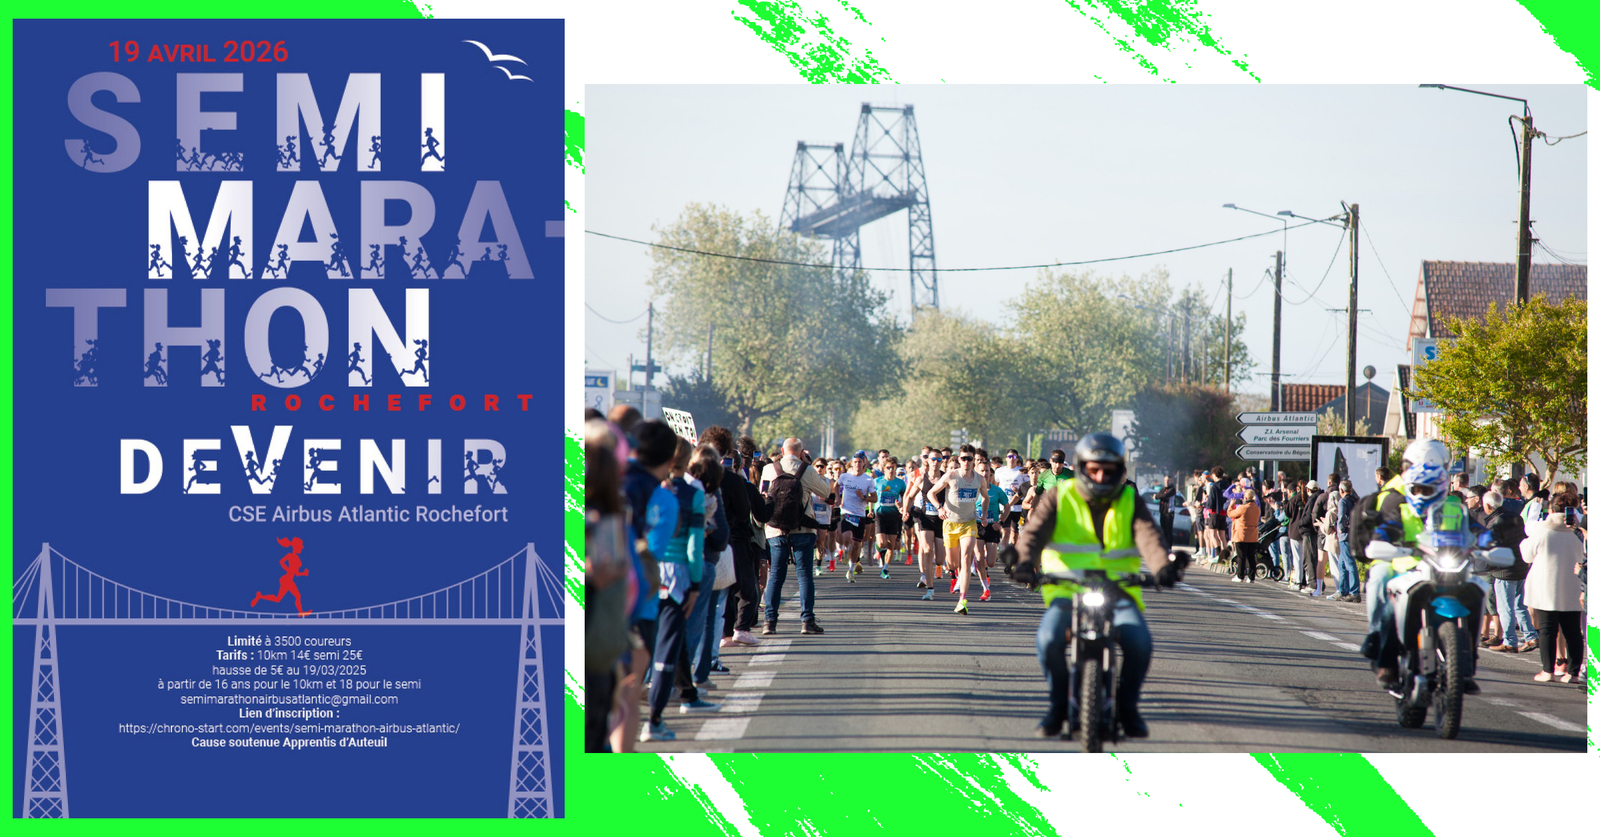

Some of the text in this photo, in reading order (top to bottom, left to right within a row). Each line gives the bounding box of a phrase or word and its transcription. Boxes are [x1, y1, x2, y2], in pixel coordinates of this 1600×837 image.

[109, 40, 288, 62] 19 AVRIL 2026
[65, 71, 445, 173] SEMI
[46, 287, 429, 388] THON
[252, 394, 533, 411] ROCHEFORT
[665, 411, 674, 421] ON
[229, 505, 508, 522] CSE Airbus Atlantic Rochefort
[228, 635, 351, 646] Limité à 3500 coureurs
[216, 649, 247, 660] Tarifs
[258, 650, 287, 660] 10km
[291, 650, 310, 660] 14€
[314, 650, 339, 660] semi
[343, 650, 362, 660] 25€
[213, 665, 366, 676] hausse de 5€ au 19/03/2025
[158, 678, 421, 691] à partir de 16 ans pour le 10km et 18 pour le semi
[181, 694, 398, 707] semimarathonairbusatlantic@gmail.com
[239, 707, 262, 718] Lien
[119, 722, 460, 735] https://chrono-start.com/events/semi-marathon-airbus-atlantic/
[192, 737, 226, 747] Cause
[229, 737, 280, 747] soutenue
[283, 736, 336, 750] Apprentis
